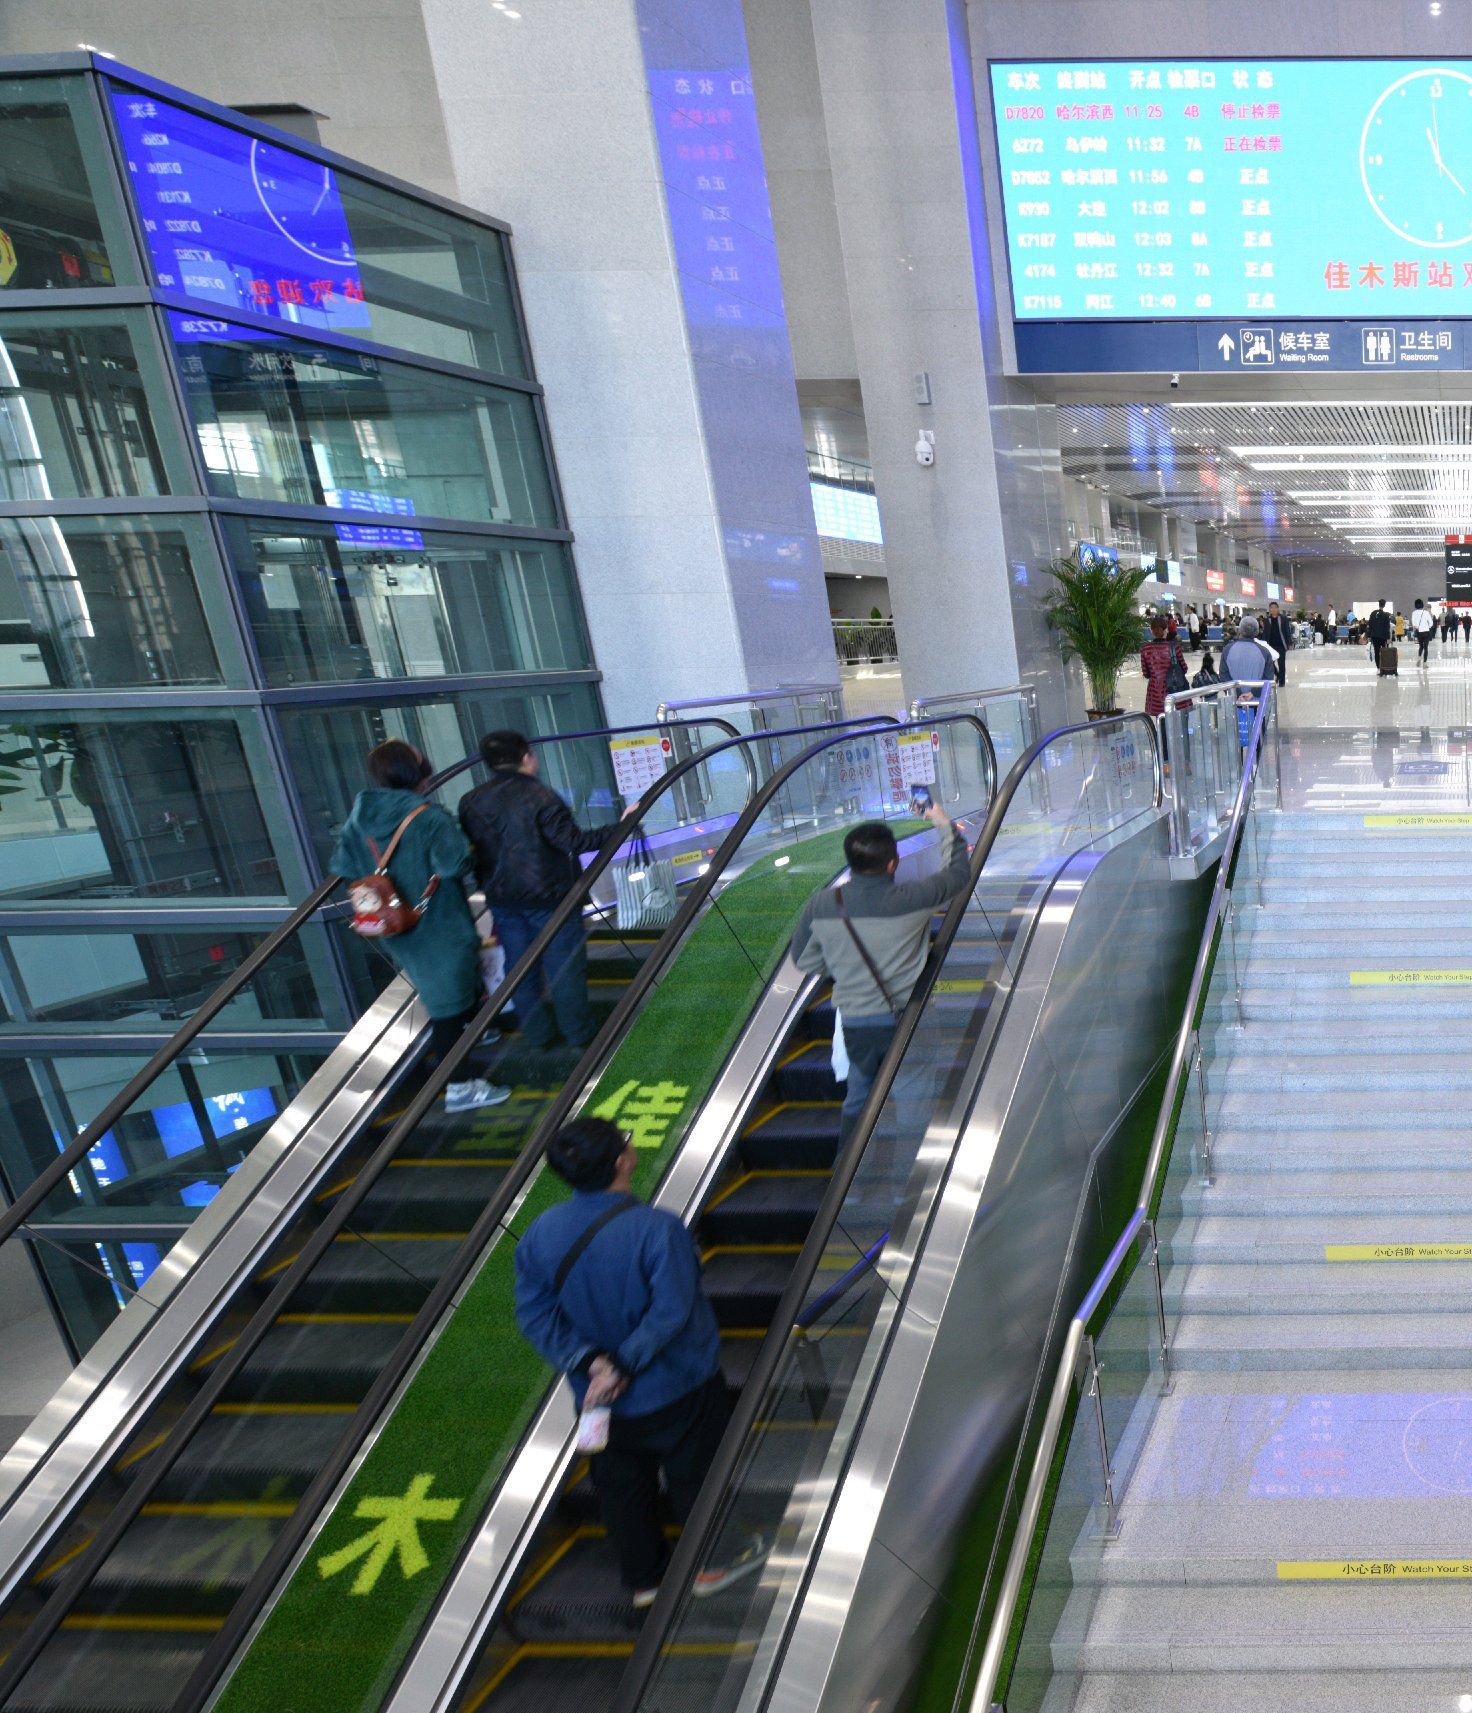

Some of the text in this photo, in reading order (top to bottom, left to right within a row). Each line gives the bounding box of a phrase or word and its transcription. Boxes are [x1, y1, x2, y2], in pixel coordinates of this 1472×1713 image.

[1008, 71, 1040, 90] 车次
[1129, 70, 1162, 89] 开点
[1006, 103, 1280, 120] D7820 哈尔滨西 11:25 4B 停止检票
[1127, 137, 1165, 151] 11:32
[1185, 137, 1202, 151] 7A
[1224, 136, 1282, 151] 正在检票
[1240, 167, 1269, 184] 正点
[1132, 200, 1169, 215] 12:02
[1242, 199, 1271, 215] 正点
[1135, 232, 1172, 246] 12:03
[1244, 230, 1272, 247] 正点
[1024, 264, 1056, 278] 4174
[1076, 263, 1118, 278] 牡丹江
[1193, 263, 1210, 276] 7A
[1245, 261, 1273, 277] 正点
[1139, 294, 1176, 307] 12:40
[1248, 293, 1275, 308] 正点
[1280, 332, 1330, 351] 候车室
[1400, 331, 1452, 350] 卫生间
[1280, 354, 1306, 363] Waiting
[1374, 1247, 1414, 1257] 小心台阶
[317, 1472, 464, 1596] 木
[1342, 1563, 1396, 1575] 小心台阶
[1402, 1565, 1434, 1574] Watch
[1436, 1564, 1460, 1573] Your
